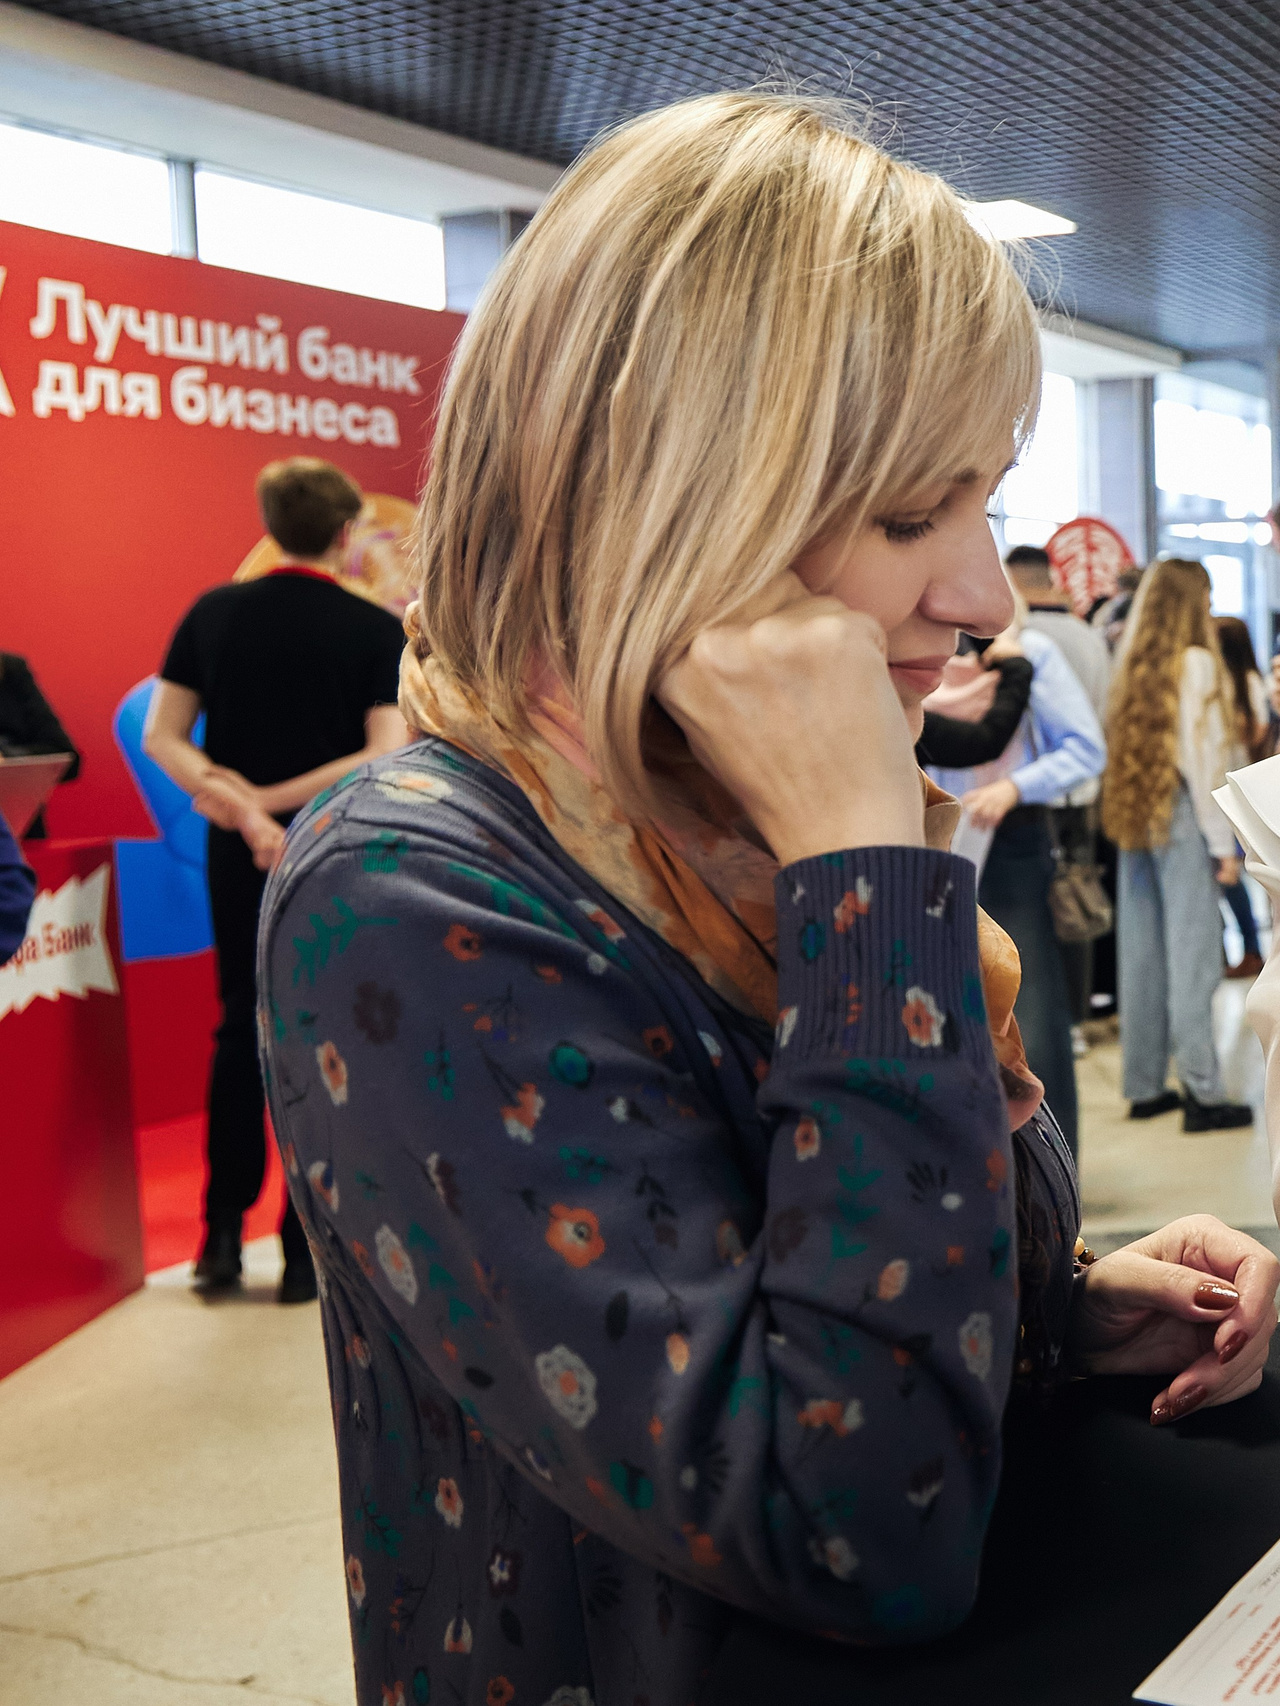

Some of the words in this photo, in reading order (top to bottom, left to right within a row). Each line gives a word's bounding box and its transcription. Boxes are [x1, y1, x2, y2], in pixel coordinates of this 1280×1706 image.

[30, 276, 291, 376] Лучший
[297, 326, 424, 396] банк
[32, 359, 162, 422] для
[170, 366, 401, 449] бизнеса
